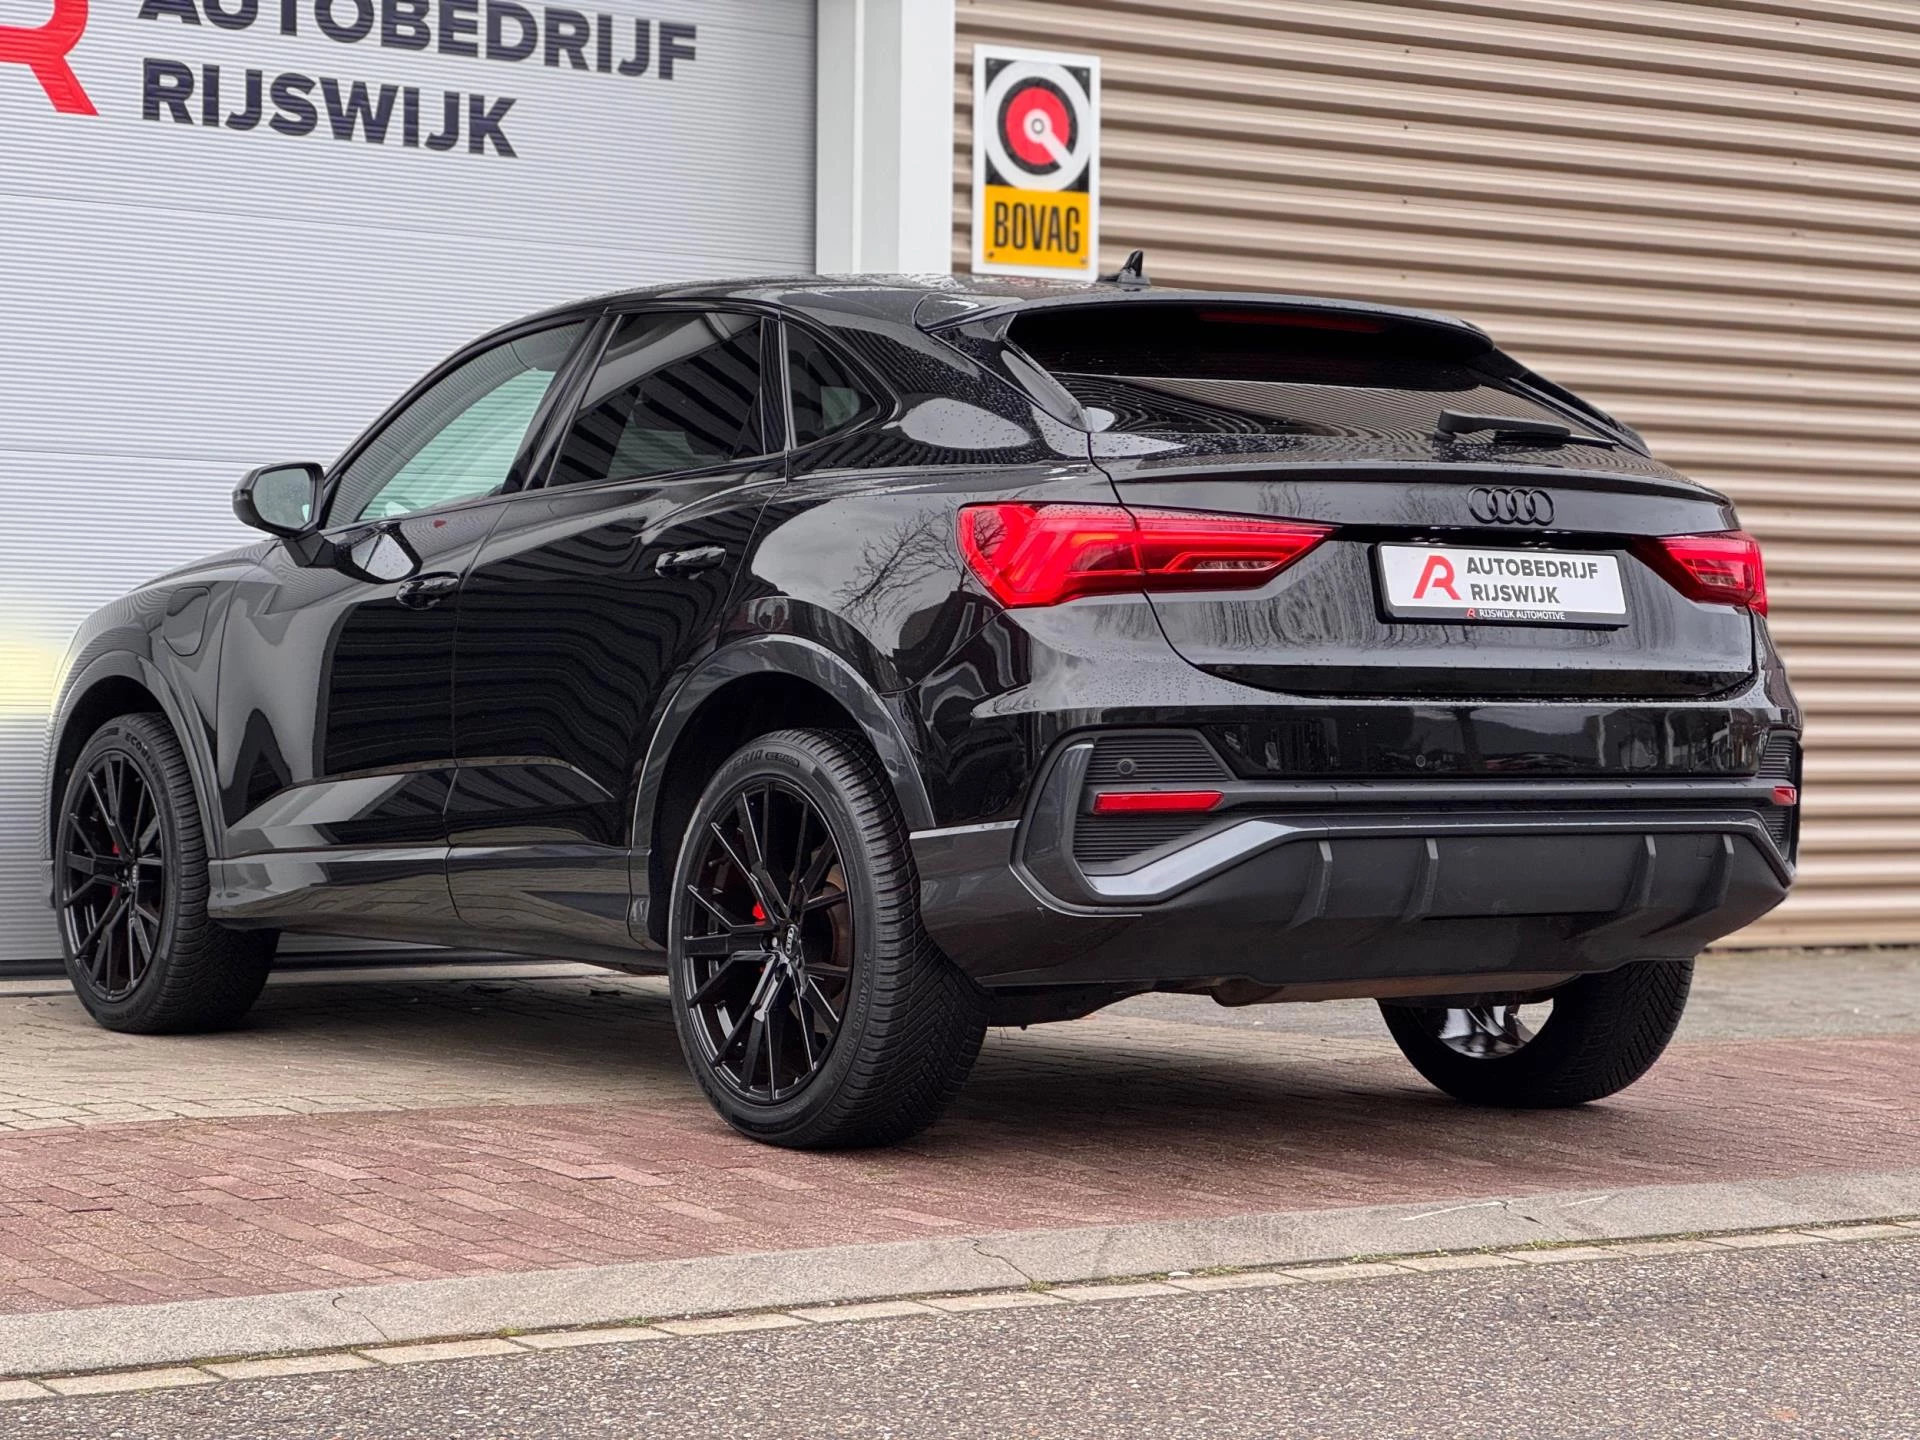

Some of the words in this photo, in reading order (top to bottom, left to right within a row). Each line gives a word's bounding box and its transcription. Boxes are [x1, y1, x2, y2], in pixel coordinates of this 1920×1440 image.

[143, 57, 518, 158] RIJSWIJK
[993, 201, 1081, 254] BOVAG
[1467, 556, 1599, 580] AUTOBEDRIJF
[1470, 583, 1560, 604] RIJSWIJK
[1478, 608, 1515, 619] RIJSWIJK
[1516, 609, 1566, 620] AUTOMOTIVE
